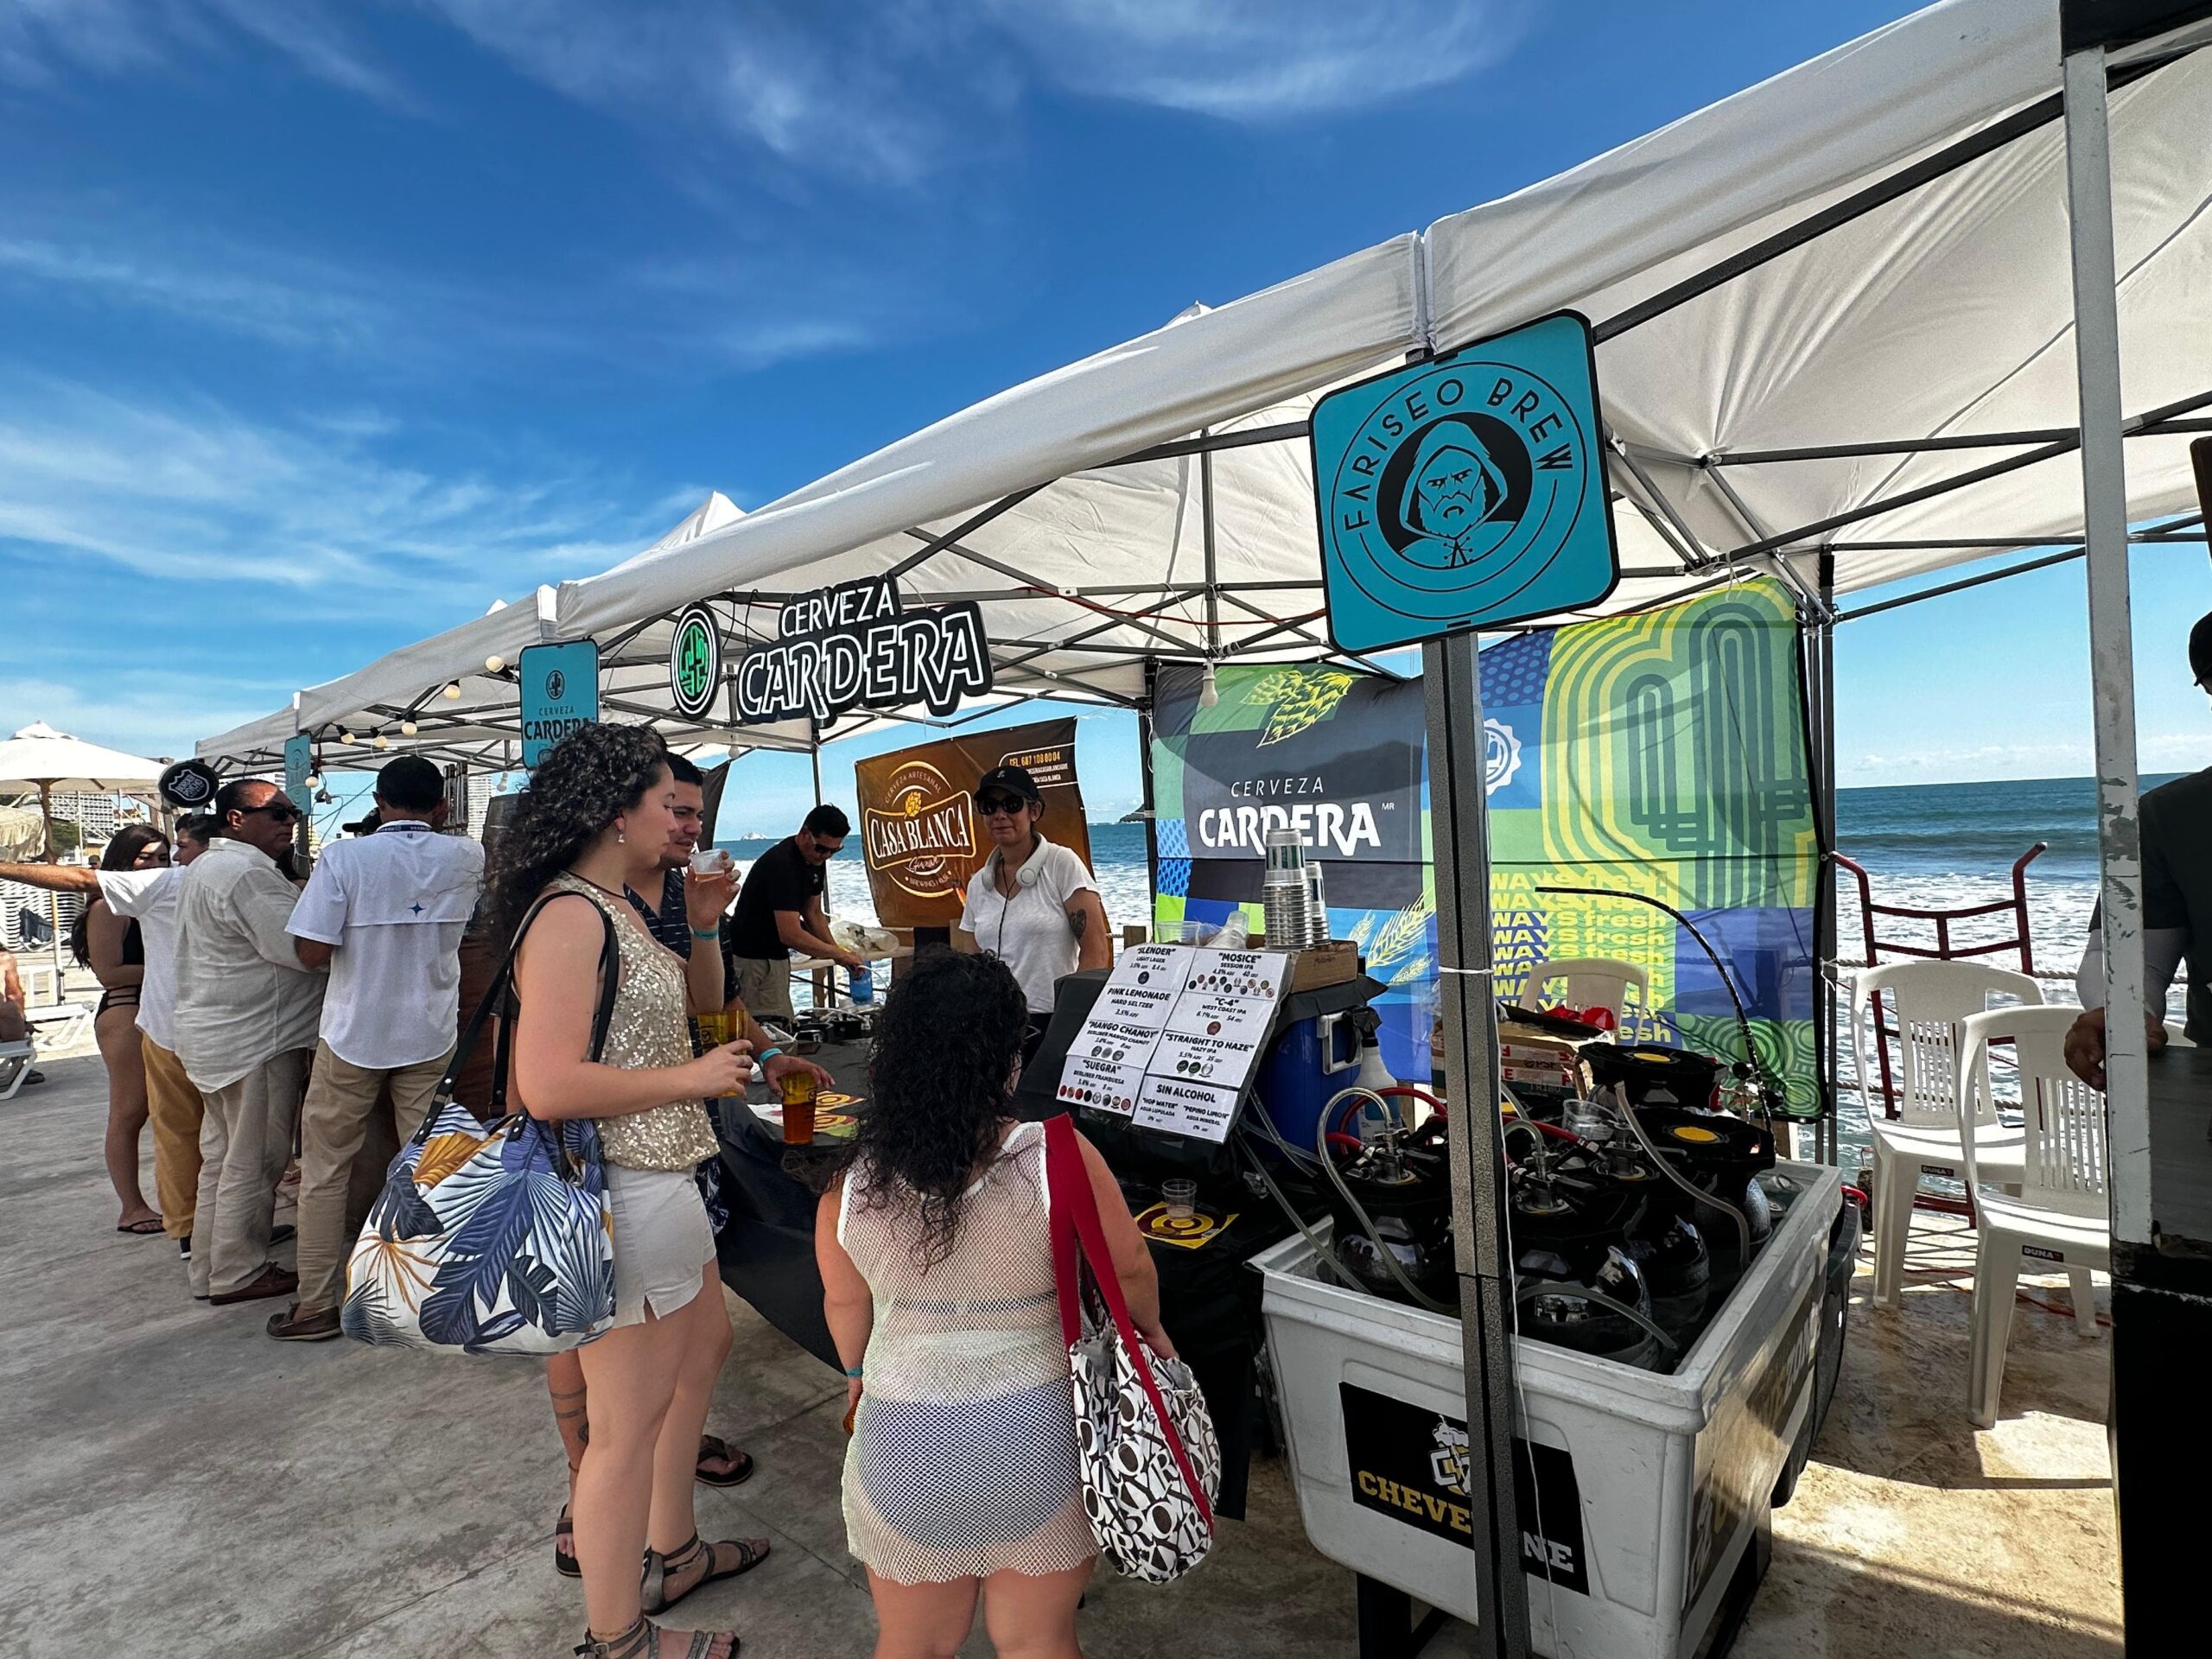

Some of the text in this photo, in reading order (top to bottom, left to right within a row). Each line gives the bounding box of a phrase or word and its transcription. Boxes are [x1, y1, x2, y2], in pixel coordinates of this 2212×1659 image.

[1343, 377, 1573, 531] FARISEO BREW
[781, 582, 894, 637] CERVEZA
[739, 611, 984, 719] CARDERA
[538, 705, 575, 716] CERVEZA
[885, 771, 942, 804] CERVEZA ARTESANAL
[1230, 777, 1324, 798] CERVEZA
[1382, 802, 1395, 810] MR
[870, 804, 970, 859] CASA BLANCA
[1198, 802, 1382, 857] CARDERA
[1584, 910, 1667, 928] fresh
[1585, 928, 1665, 946] fresh
[1125, 988, 1171, 1001] LEMONADE
[1128, 1000, 1154, 1008] SELTZER
[1211, 1039, 1224, 1048] TO
[1156, 1084, 1216, 1103] SIN ALCOHOL
[2024, 1247, 2054, 1259] DUNA
[1358, 1471, 1574, 1573] CHEVENE
